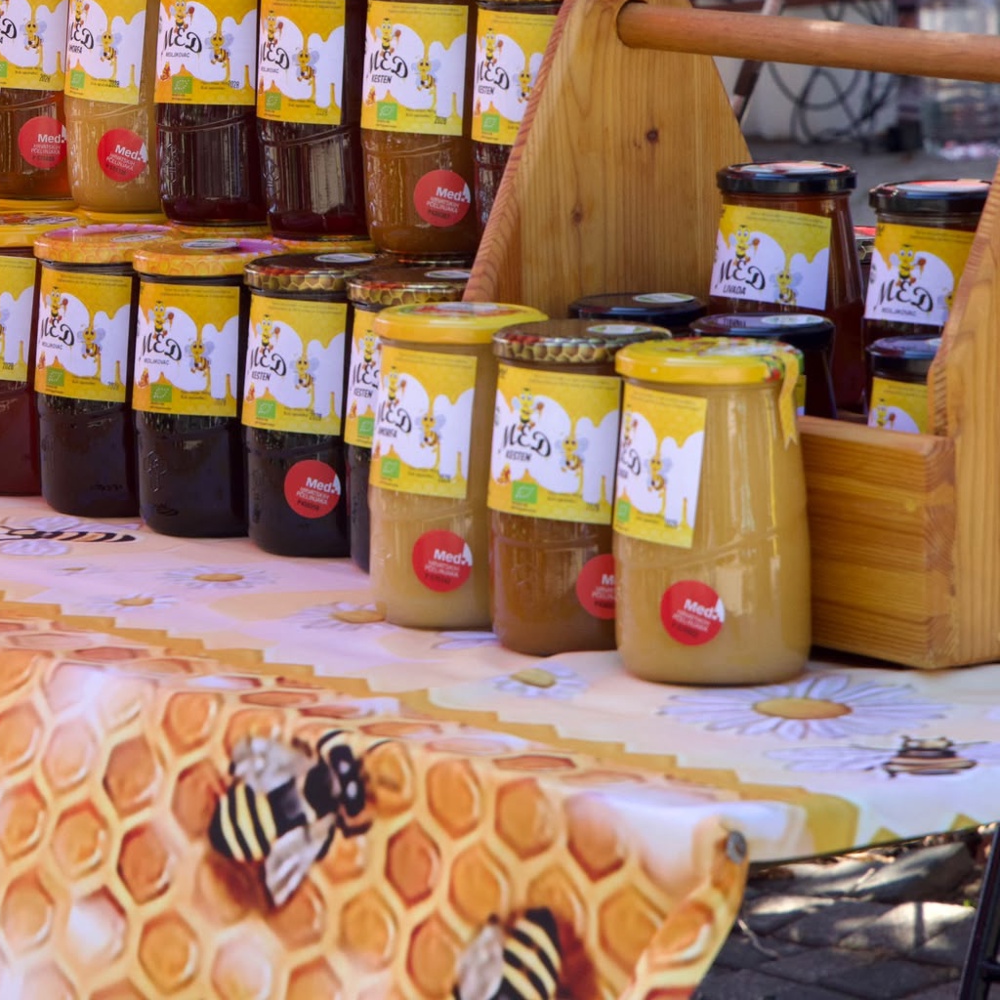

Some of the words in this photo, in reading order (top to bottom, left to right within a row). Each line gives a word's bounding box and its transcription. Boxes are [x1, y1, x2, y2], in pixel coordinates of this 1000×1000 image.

[163, 27, 203, 54] MED
[368, 51, 408, 78] MED
[476, 60, 510, 90] MED
[720, 259, 766, 291] MED
[877, 279, 934, 313] MED
[40, 317, 75, 347] MED
[141, 332, 182, 361] MED
[250, 347, 287, 377] MED
[502, 424, 551, 458] MED
[620, 448, 641, 477] ED
